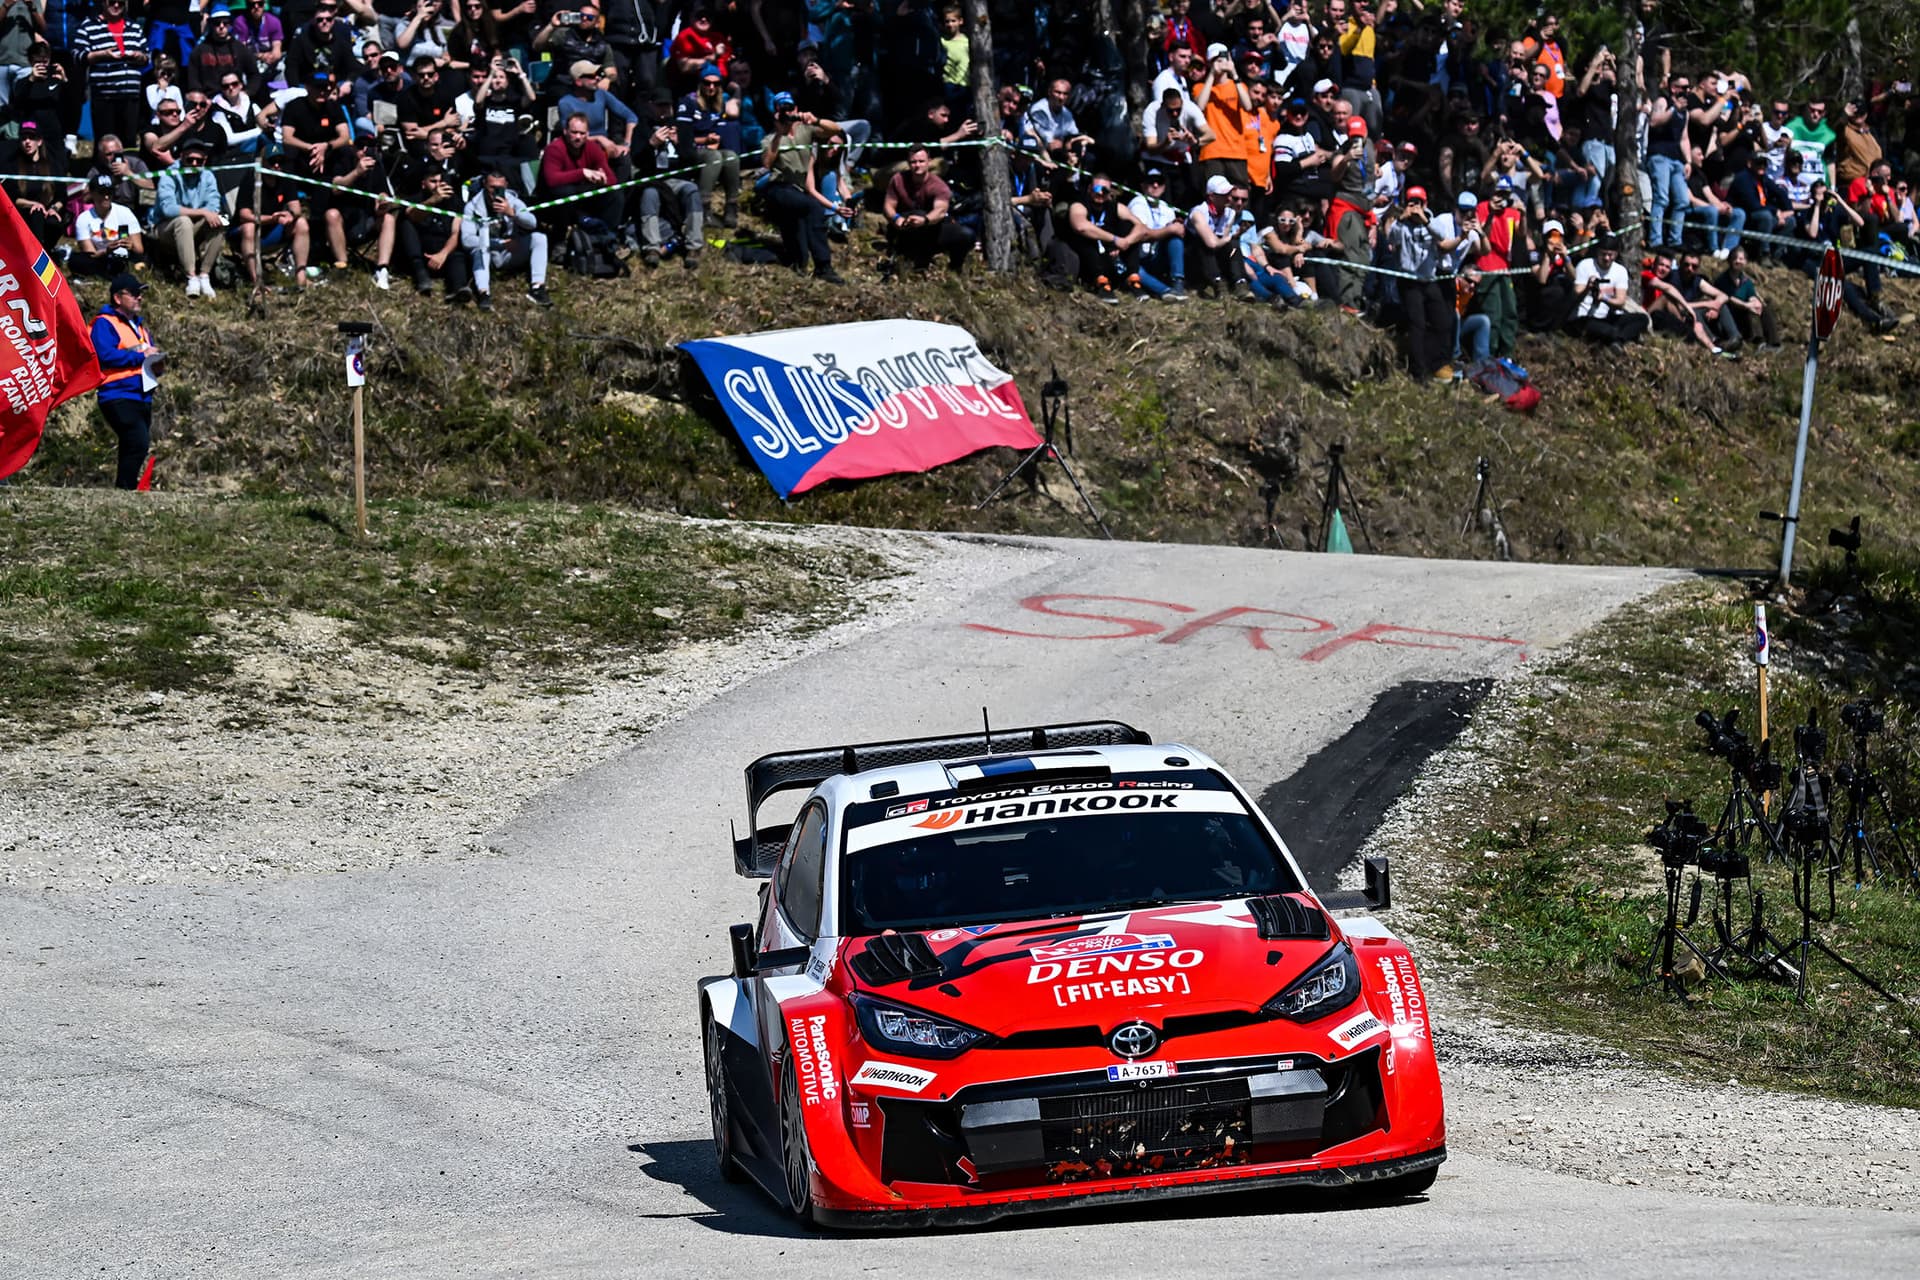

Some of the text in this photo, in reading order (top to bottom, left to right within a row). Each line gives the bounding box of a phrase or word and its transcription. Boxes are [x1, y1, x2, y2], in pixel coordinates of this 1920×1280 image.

[1817, 274, 1842, 312] STOP
[0, 315, 52, 400] ROMANIAN
[0, 377, 28, 415] FANS
[10, 366, 41, 406] RALLY
[723, 346, 1022, 459] SLUŠOVICE
[886, 781, 1194, 818] GR TOYOTA GAZOO Racing
[1027, 949, 1204, 984] DENSO
[1394, 954, 1426, 1040] AUTOMOTIVE
[790, 1018, 820, 1106] AUTOMOTIVE
[808, 1014, 839, 1100] Panasonic
[1122, 1064, 1163, 1078] A-7657
[851, 1107, 869, 1123] OMP
